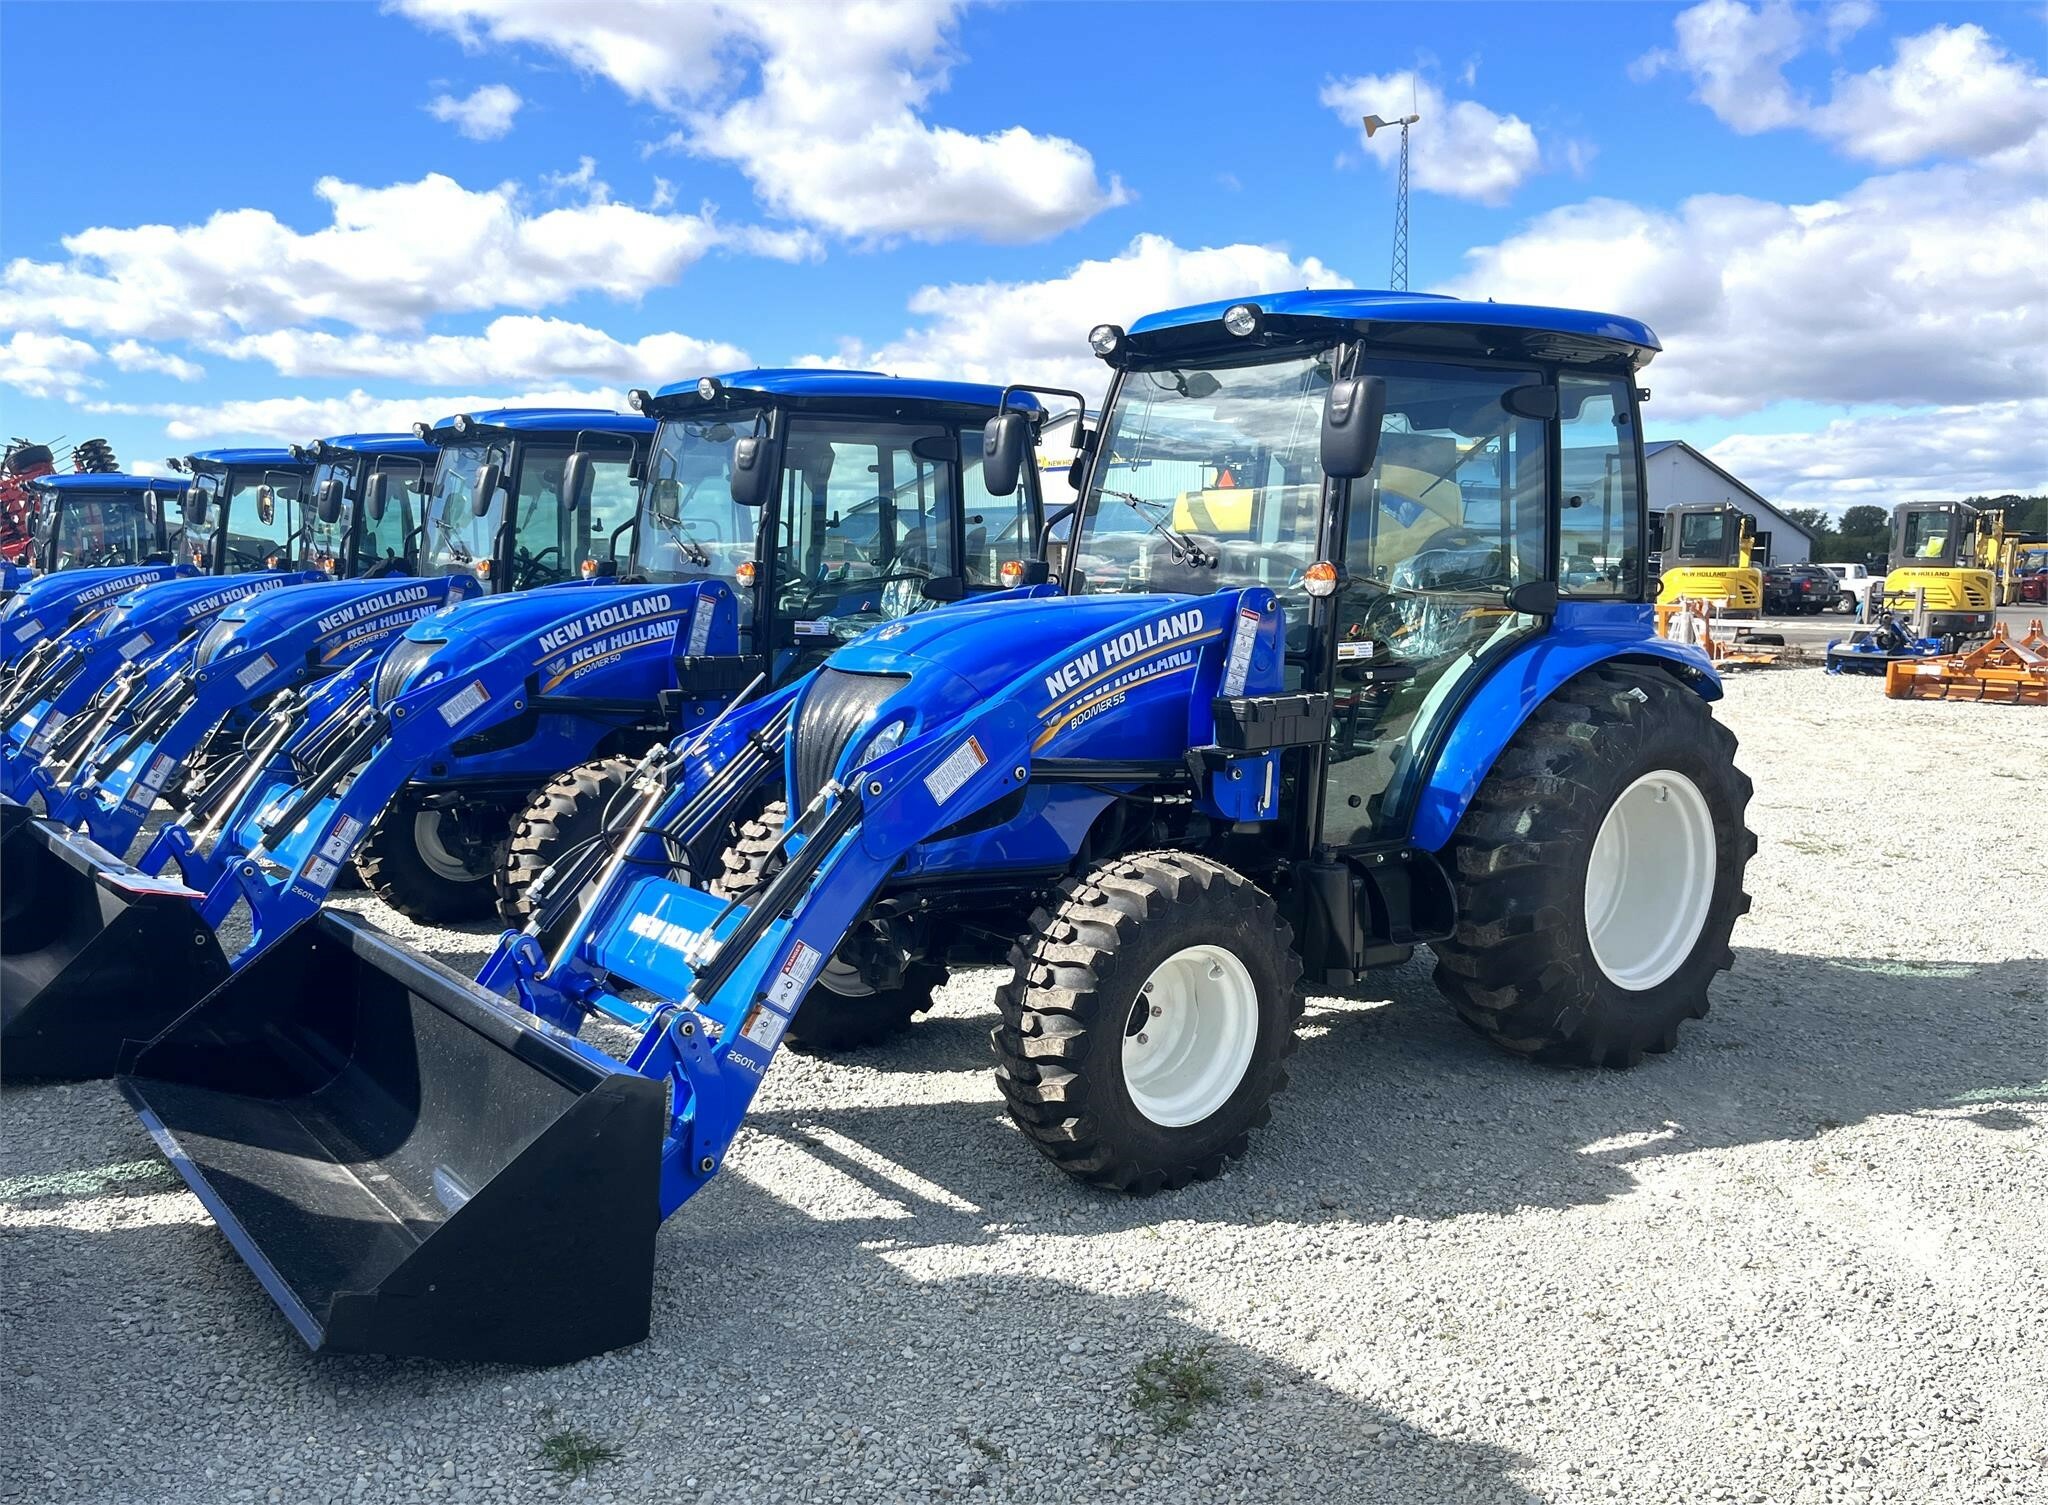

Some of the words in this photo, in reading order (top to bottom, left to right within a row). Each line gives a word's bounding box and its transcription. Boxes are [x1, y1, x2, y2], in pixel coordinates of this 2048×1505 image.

[77, 587, 105, 603] NEW
[105, 572, 160, 592] HOLLAND
[187, 596, 219, 617] NEW
[221, 579, 283, 603] HOLLAND
[318, 606, 354, 633] NEW
[358, 585, 428, 616] HOLLAND
[539, 619, 583, 653] NEW
[585, 594, 671, 632] HOLLAND
[347, 620, 377, 640] NEW
[349, 634, 379, 651] BOOMER
[571, 639, 607, 665] NEW
[610, 619, 679, 653] HOLLAND
[574, 657, 610, 680] BOOMER
[610, 653, 621, 664] 50
[1045, 649, 1099, 700] NEW
[1101, 608, 1203, 666] HOLLAND
[1071, 699, 1113, 730] BOOMER
[1113, 692, 1126, 706] 55
[628, 911, 668, 940] NEW
